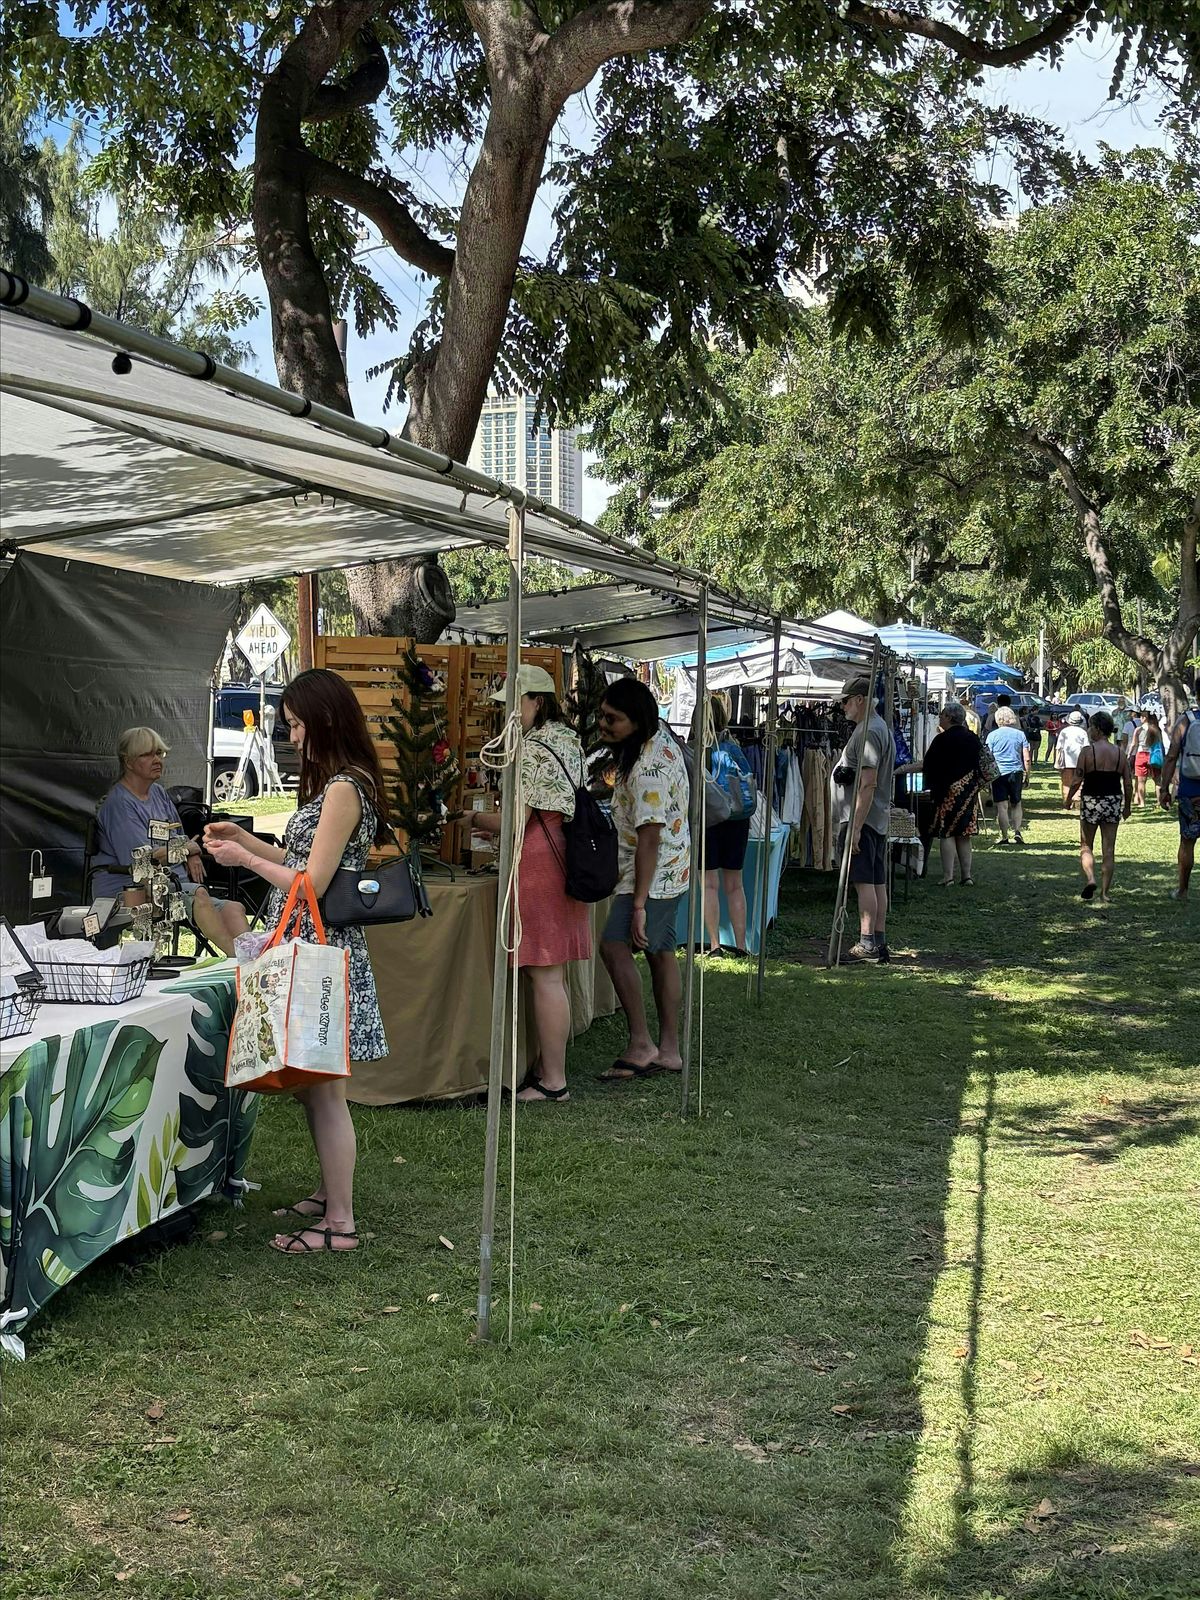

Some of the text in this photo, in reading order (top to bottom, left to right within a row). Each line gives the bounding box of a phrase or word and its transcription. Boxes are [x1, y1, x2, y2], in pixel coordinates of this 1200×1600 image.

[250, 625, 276, 638] YIELD
[249, 641, 278, 654] AHEAD
[319, 976, 332, 1046] HELLO KITTY
